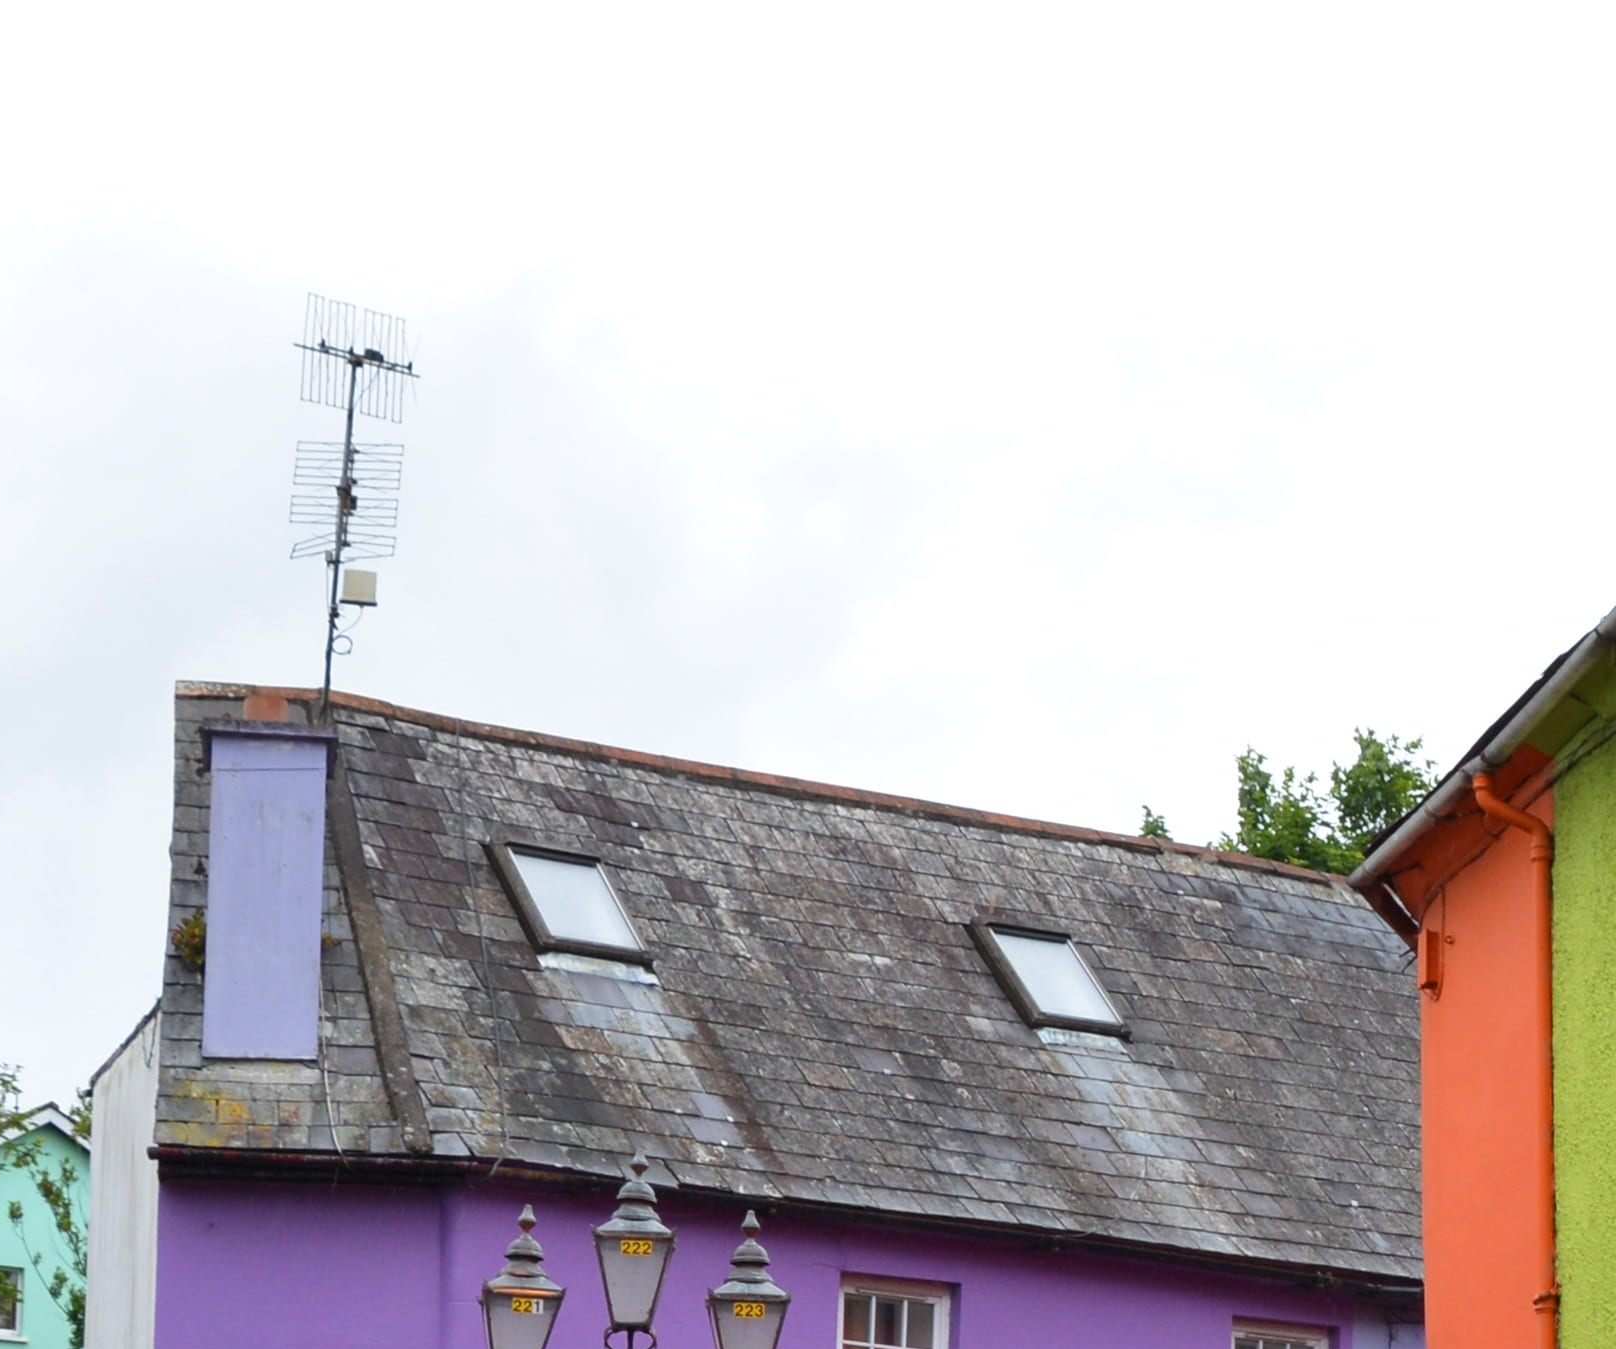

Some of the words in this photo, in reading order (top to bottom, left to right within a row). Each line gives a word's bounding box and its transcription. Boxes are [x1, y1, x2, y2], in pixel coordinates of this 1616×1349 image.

[621, 1240, 653, 1256] 222
[512, 1300, 543, 1314] 221
[734, 1304, 765, 1319] 223
